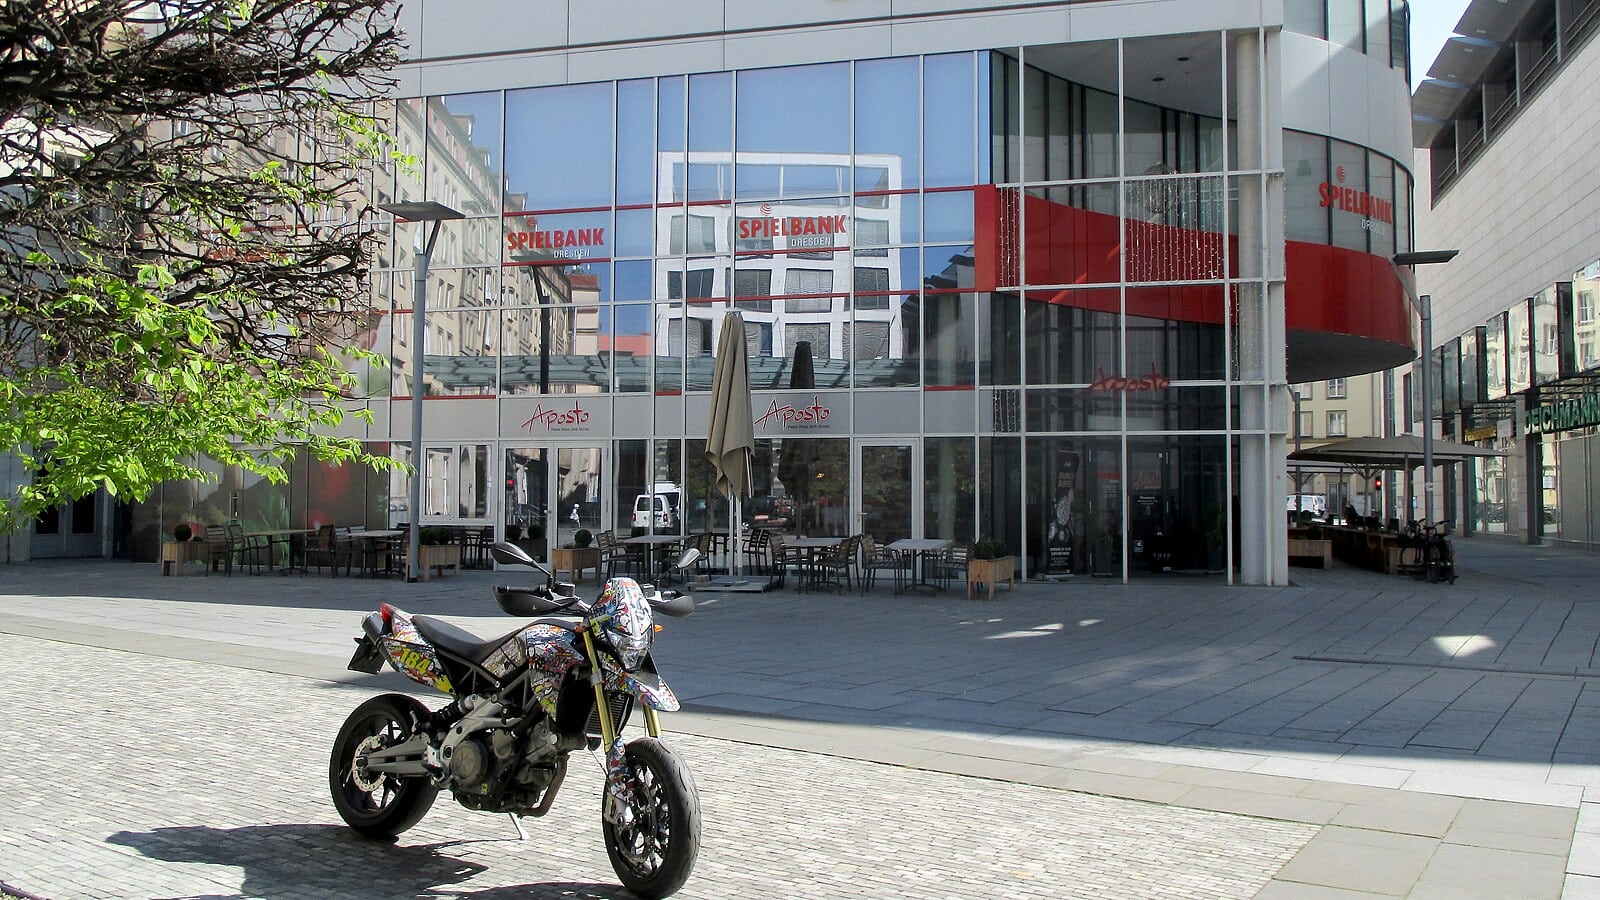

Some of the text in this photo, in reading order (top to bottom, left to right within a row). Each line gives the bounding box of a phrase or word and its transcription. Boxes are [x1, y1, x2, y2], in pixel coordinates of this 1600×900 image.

[1318, 181, 1392, 225] SPIELBANK
[507, 227, 605, 250] SPIELBANK
[739, 214, 847, 239] SPIELBANK
[554, 248, 590, 259] DRESDEN
[791, 236, 831, 247] DRESDEN
[1080, 361, 1170, 396] Aposto
[520, 400, 589, 432] Aposto
[754, 394, 830, 431] Aposto
[400, 648, 432, 675] 184
